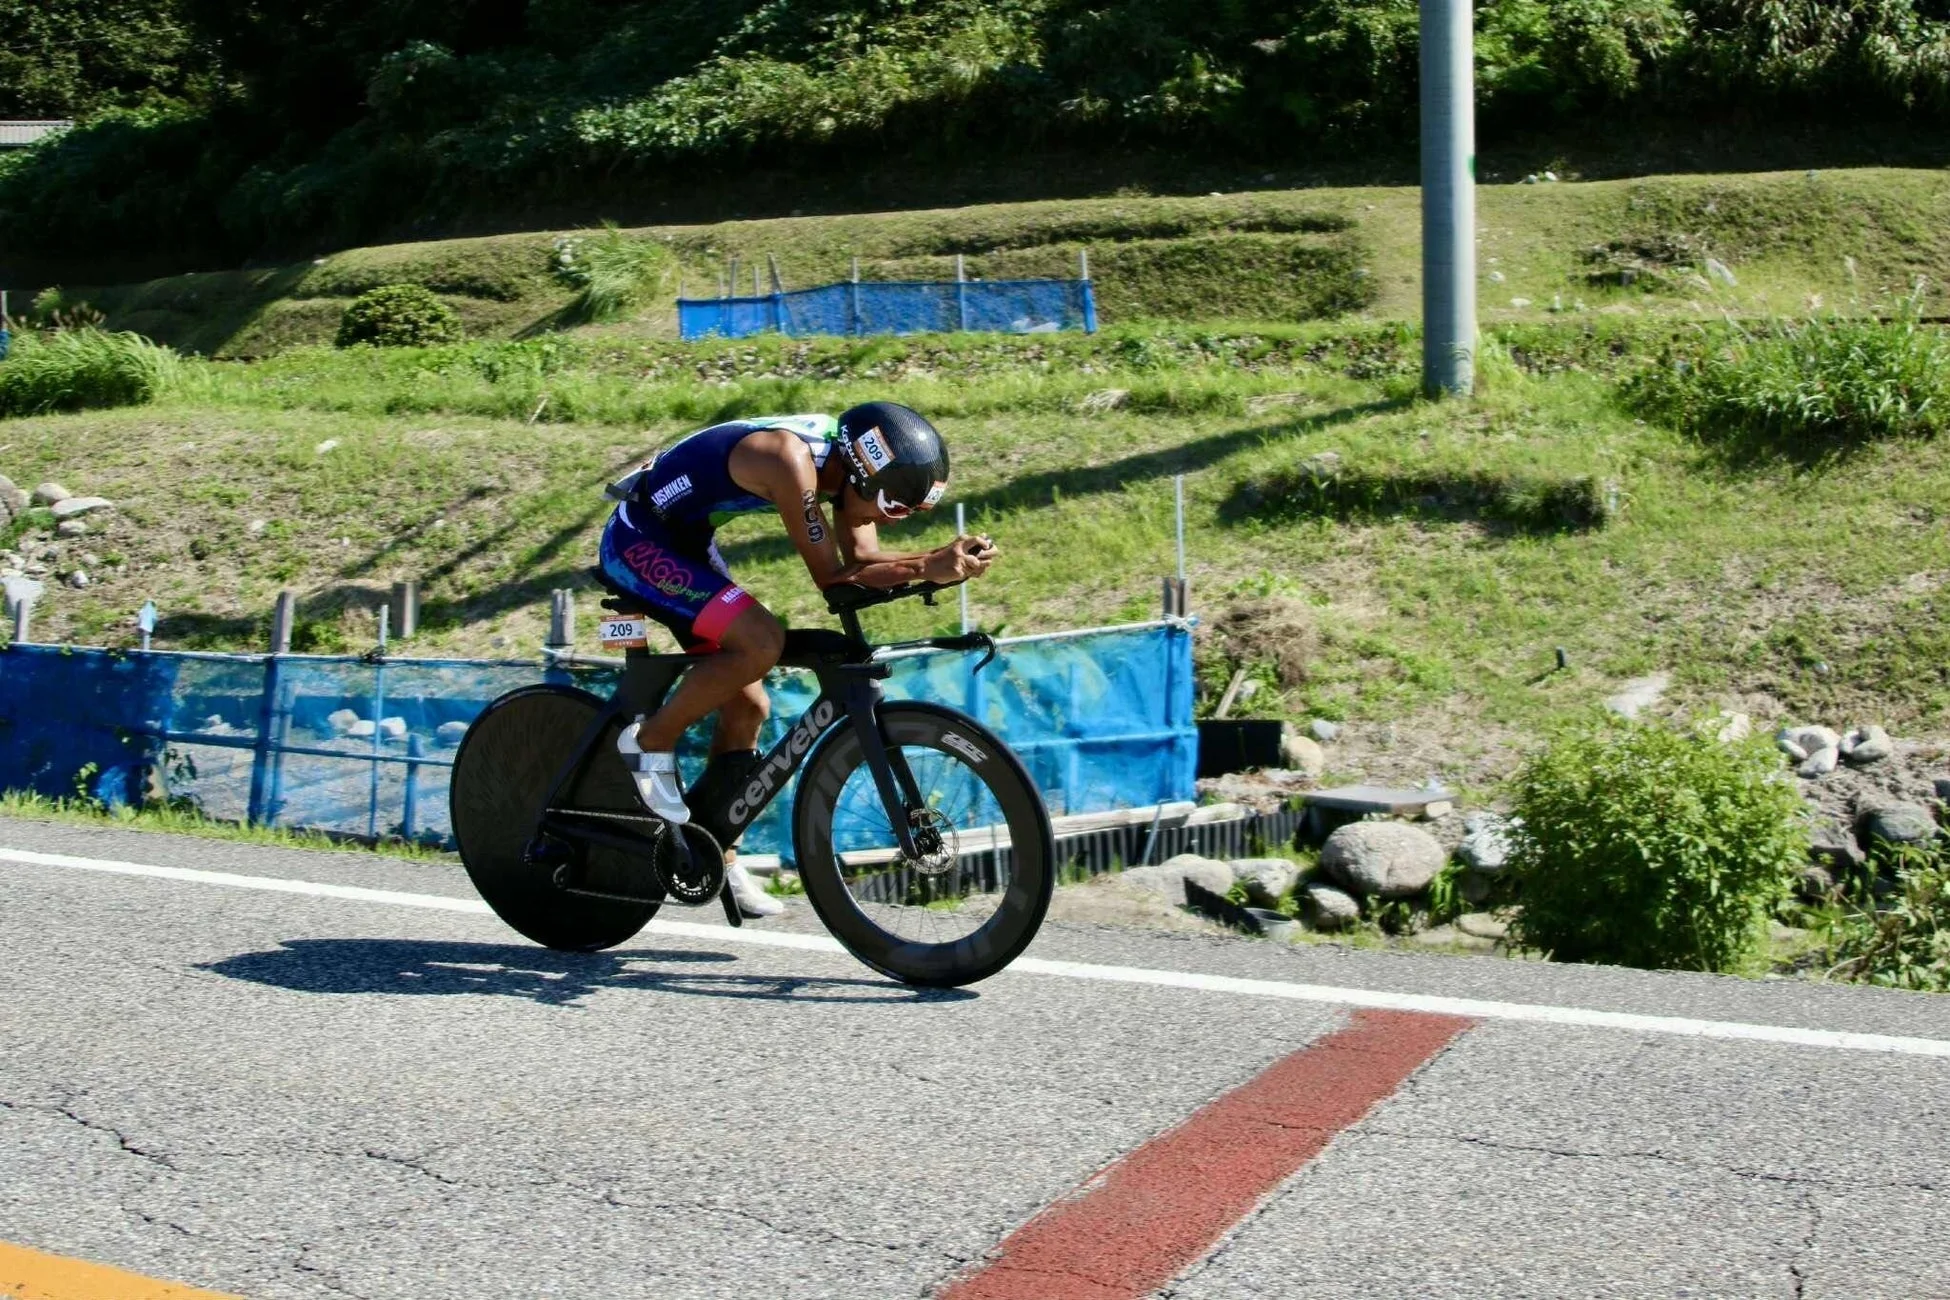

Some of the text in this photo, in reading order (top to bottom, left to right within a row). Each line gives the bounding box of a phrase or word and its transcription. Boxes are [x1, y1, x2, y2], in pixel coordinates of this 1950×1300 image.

[864, 437, 883, 461] 209
[609, 622, 633, 638] 209
[728, 699, 834, 825] cervélo
